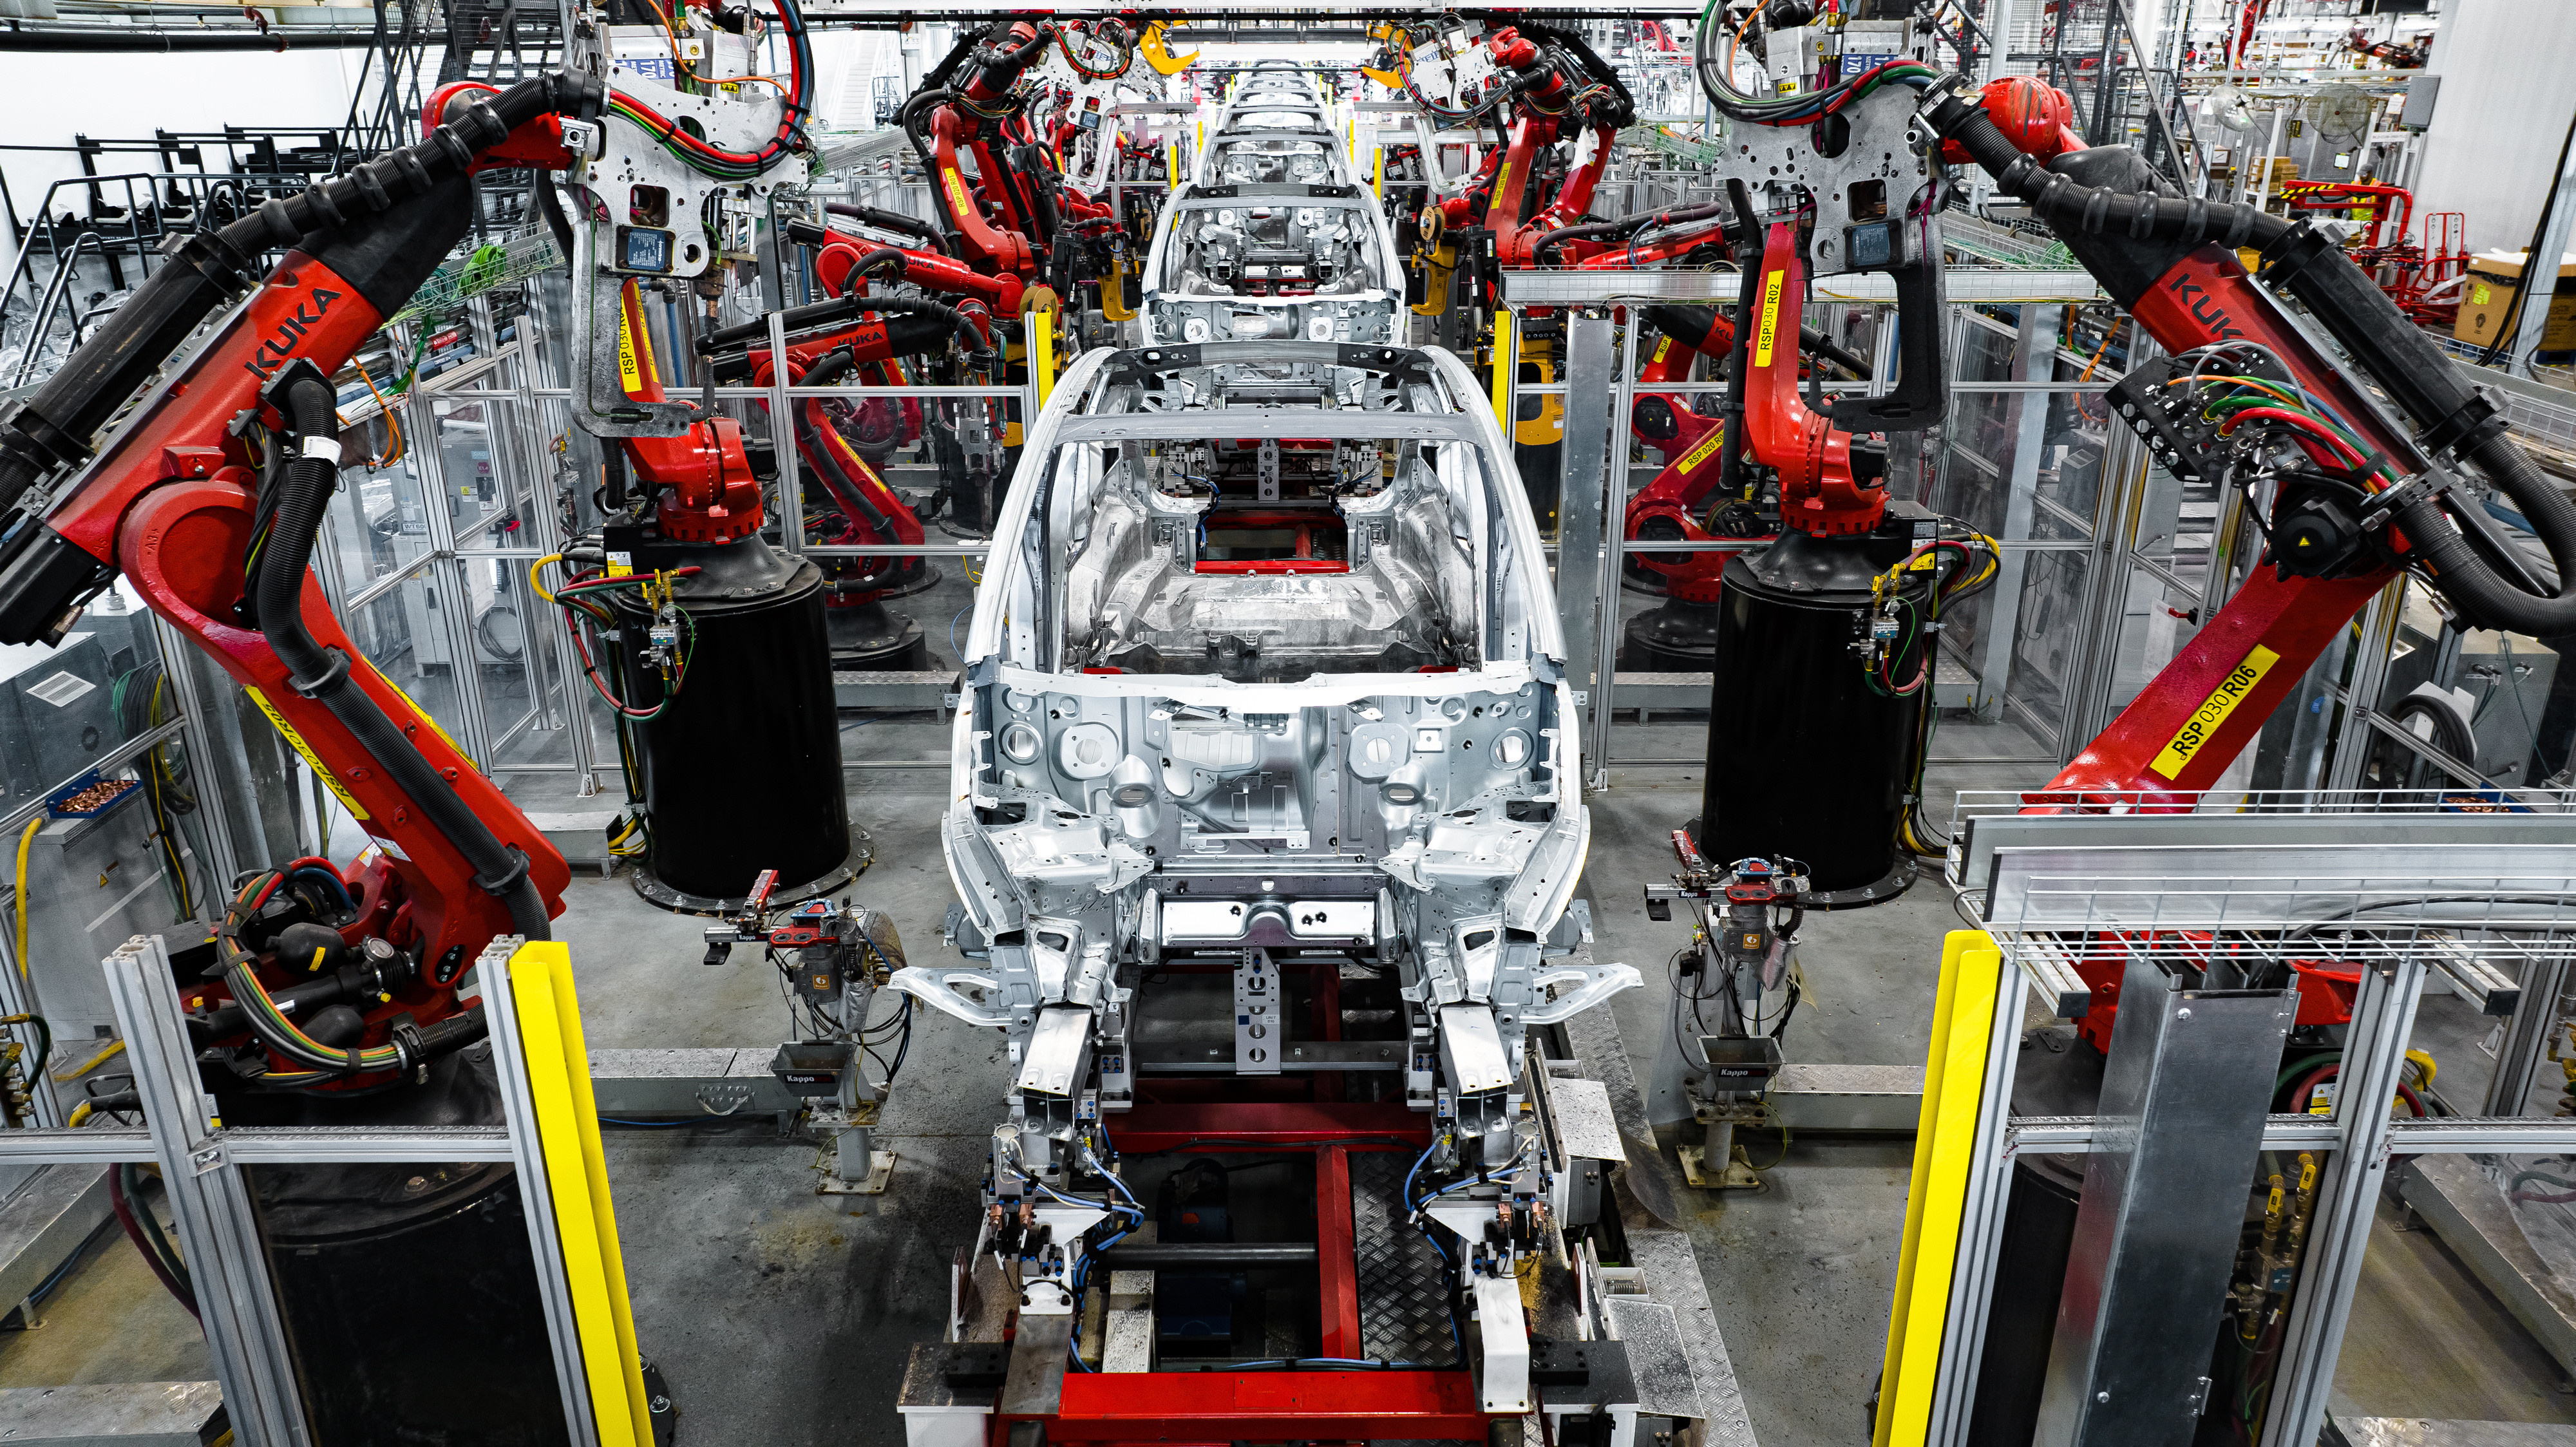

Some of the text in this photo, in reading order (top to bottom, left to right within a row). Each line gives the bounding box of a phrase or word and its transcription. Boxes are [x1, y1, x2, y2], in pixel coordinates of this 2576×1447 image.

[640, 61, 657, 79] 170
[1846, 56, 1862, 73] 170
[957, 196, 965, 207] RSP
[906, 256, 936, 270] UKA
[1767, 283, 1779, 304] R02
[2170, 272, 2245, 342] KUK
[245, 288, 342, 381] KUKA
[837, 332, 884, 346] KUKA
[1659, 339, 1668, 354] RSP
[621, 352, 635, 375] RSP
[1687, 433, 1724, 466] RSP 020 R0
[2171, 664, 2257, 757] RSP 030 R06
